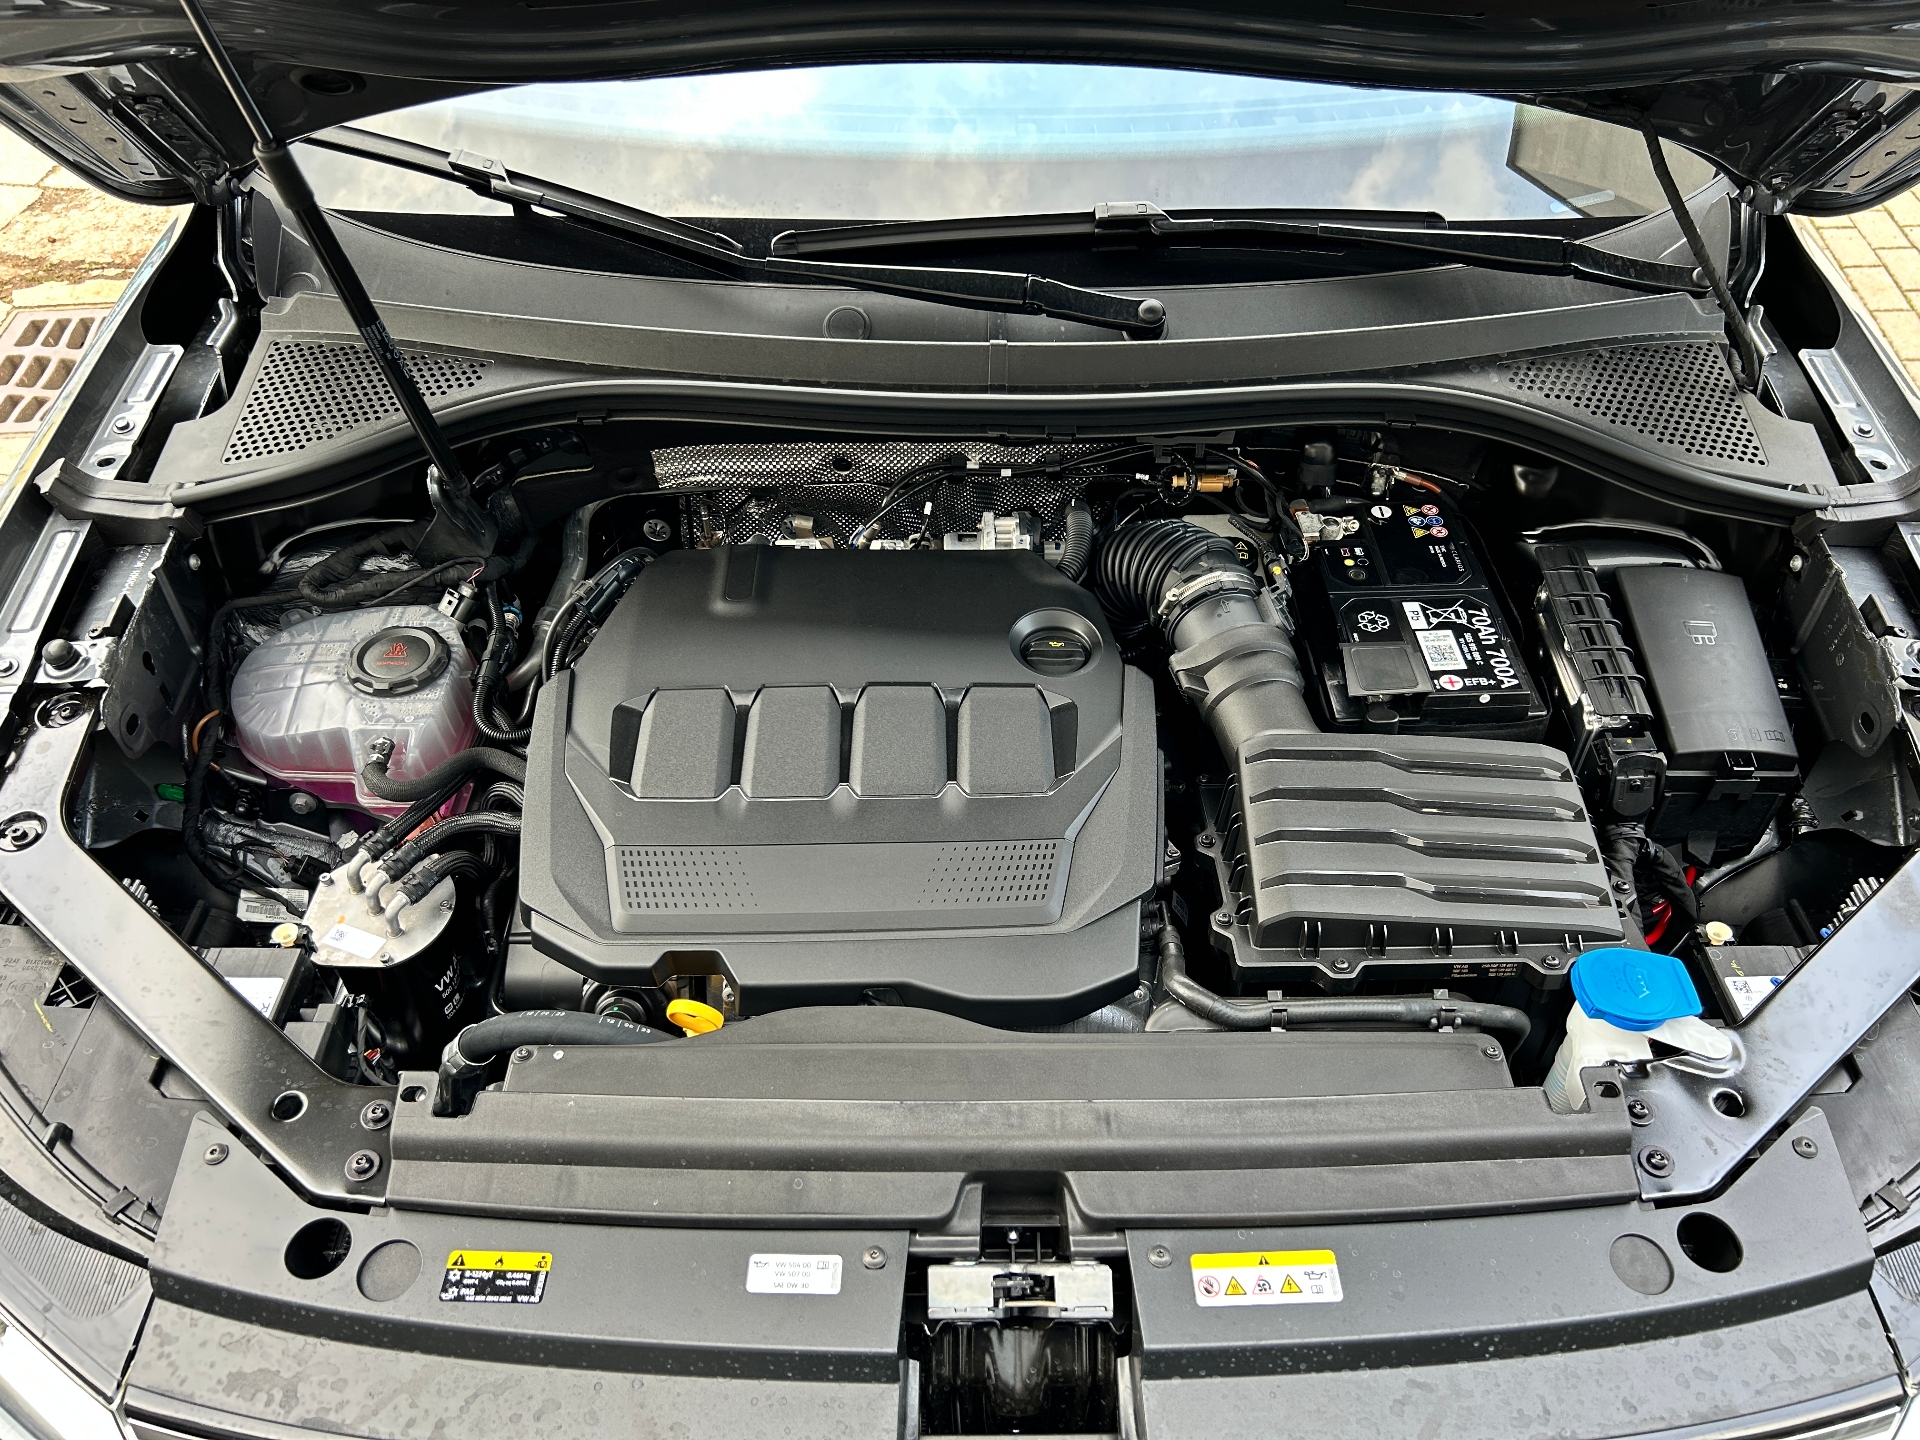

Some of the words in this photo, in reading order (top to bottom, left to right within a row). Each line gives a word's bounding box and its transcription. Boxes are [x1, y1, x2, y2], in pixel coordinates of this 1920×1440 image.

[1408, 610, 1420, 622] Pb
[1468, 608, 1499, 645] 70Ah
[1485, 648, 1520, 689] 700A
[1463, 677, 1497, 687] EFB+
[434, 965, 453, 991] VW
[788, 1270, 800, 1278] 507
[801, 1270, 811, 1278] 00
[516, 1294, 528, 1302] VW
